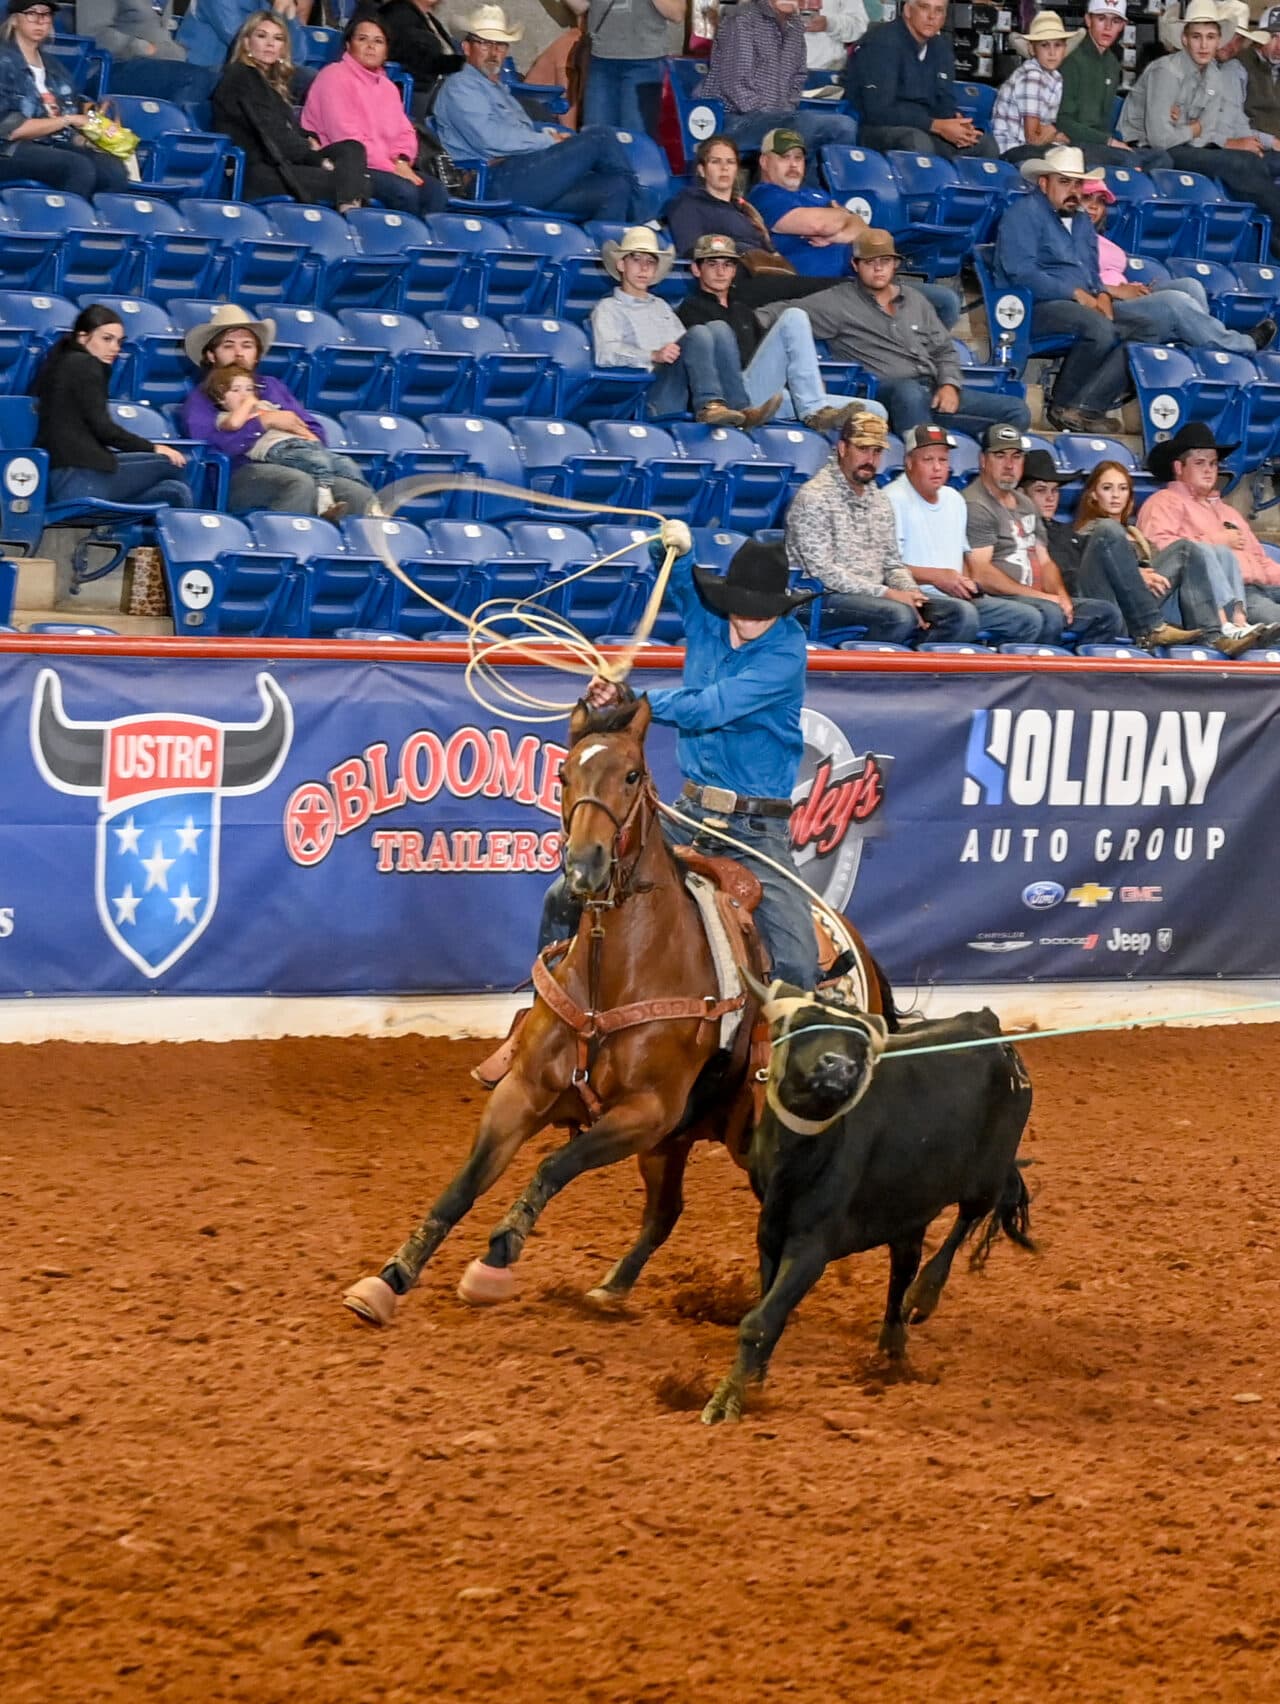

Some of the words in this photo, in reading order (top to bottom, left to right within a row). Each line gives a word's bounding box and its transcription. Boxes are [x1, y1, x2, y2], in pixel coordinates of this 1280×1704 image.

[116, 734, 214, 780] USTRC
[960, 708, 1227, 806] HOLIDAY
[329, 727, 566, 835] BLOOME
[373, 830, 563, 872] TRAILERS
[960, 828, 1069, 863] AUTO
[1095, 827, 1226, 862] GROUP
[1120, 886, 1164, 902] GMC
[1106, 928, 1152, 956] Jeep
